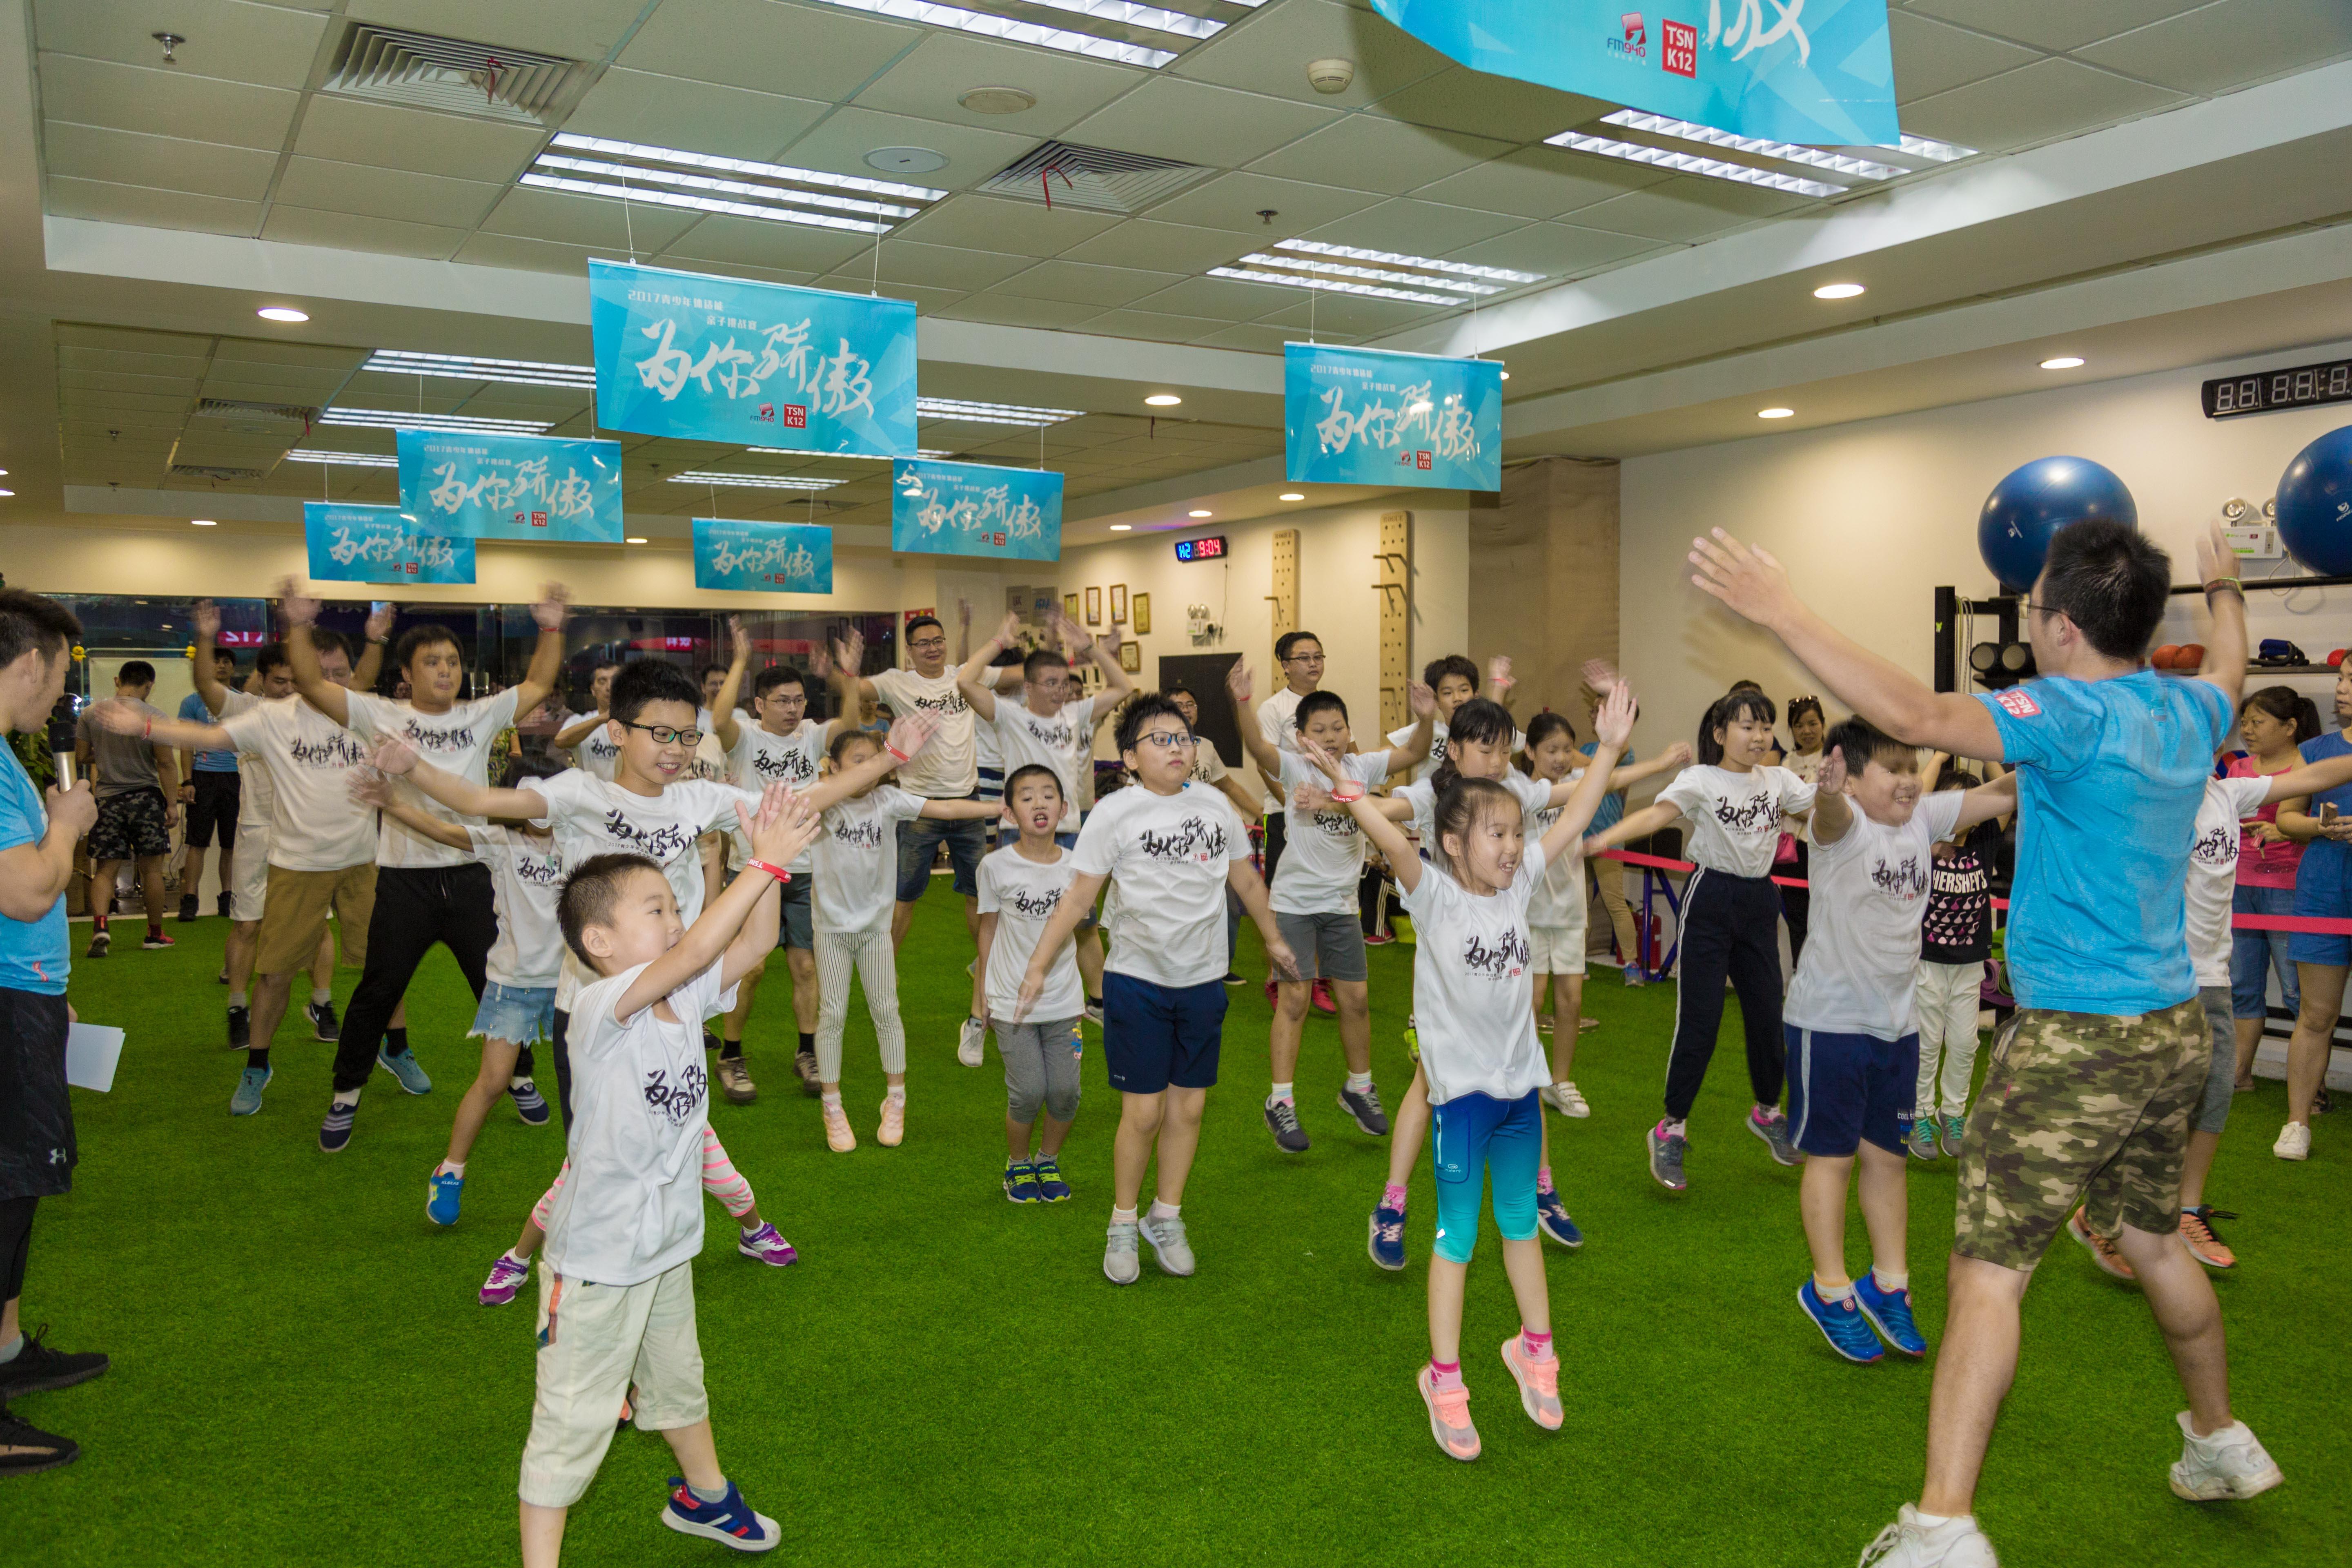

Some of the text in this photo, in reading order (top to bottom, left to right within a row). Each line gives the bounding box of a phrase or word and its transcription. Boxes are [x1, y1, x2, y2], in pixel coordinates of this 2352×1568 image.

[1607, 38, 1646, 57] FM940
[1666, 24, 1694, 49] TSN
[1667, 48, 1693, 72] K12
[635, 318, 875, 419] 为你骄傲
[786, 406, 804, 416] TSN
[787, 417, 804, 425] K12
[1316, 380, 1475, 461] 为你骄傲
[1418, 452, 1430, 460] TSN
[428, 456, 595, 519] 为你骄傲
[917, 483, 1041, 541] 为你骄傲
[712, 536, 814, 580] 为你骄傲
[1997, 696, 2020, 715] K12
[2011, 691, 2035, 713] TSN
[590, 738, 618, 758] 为你
[754, 748, 814, 781] 为你骄傲
[604, 809, 704, 857] 为你骄
[1142, 817, 1226, 860] 为你骄傲
[1933, 869, 1988, 893] HERSHEY'S
[1015, 888, 1061, 916] 为你骄
